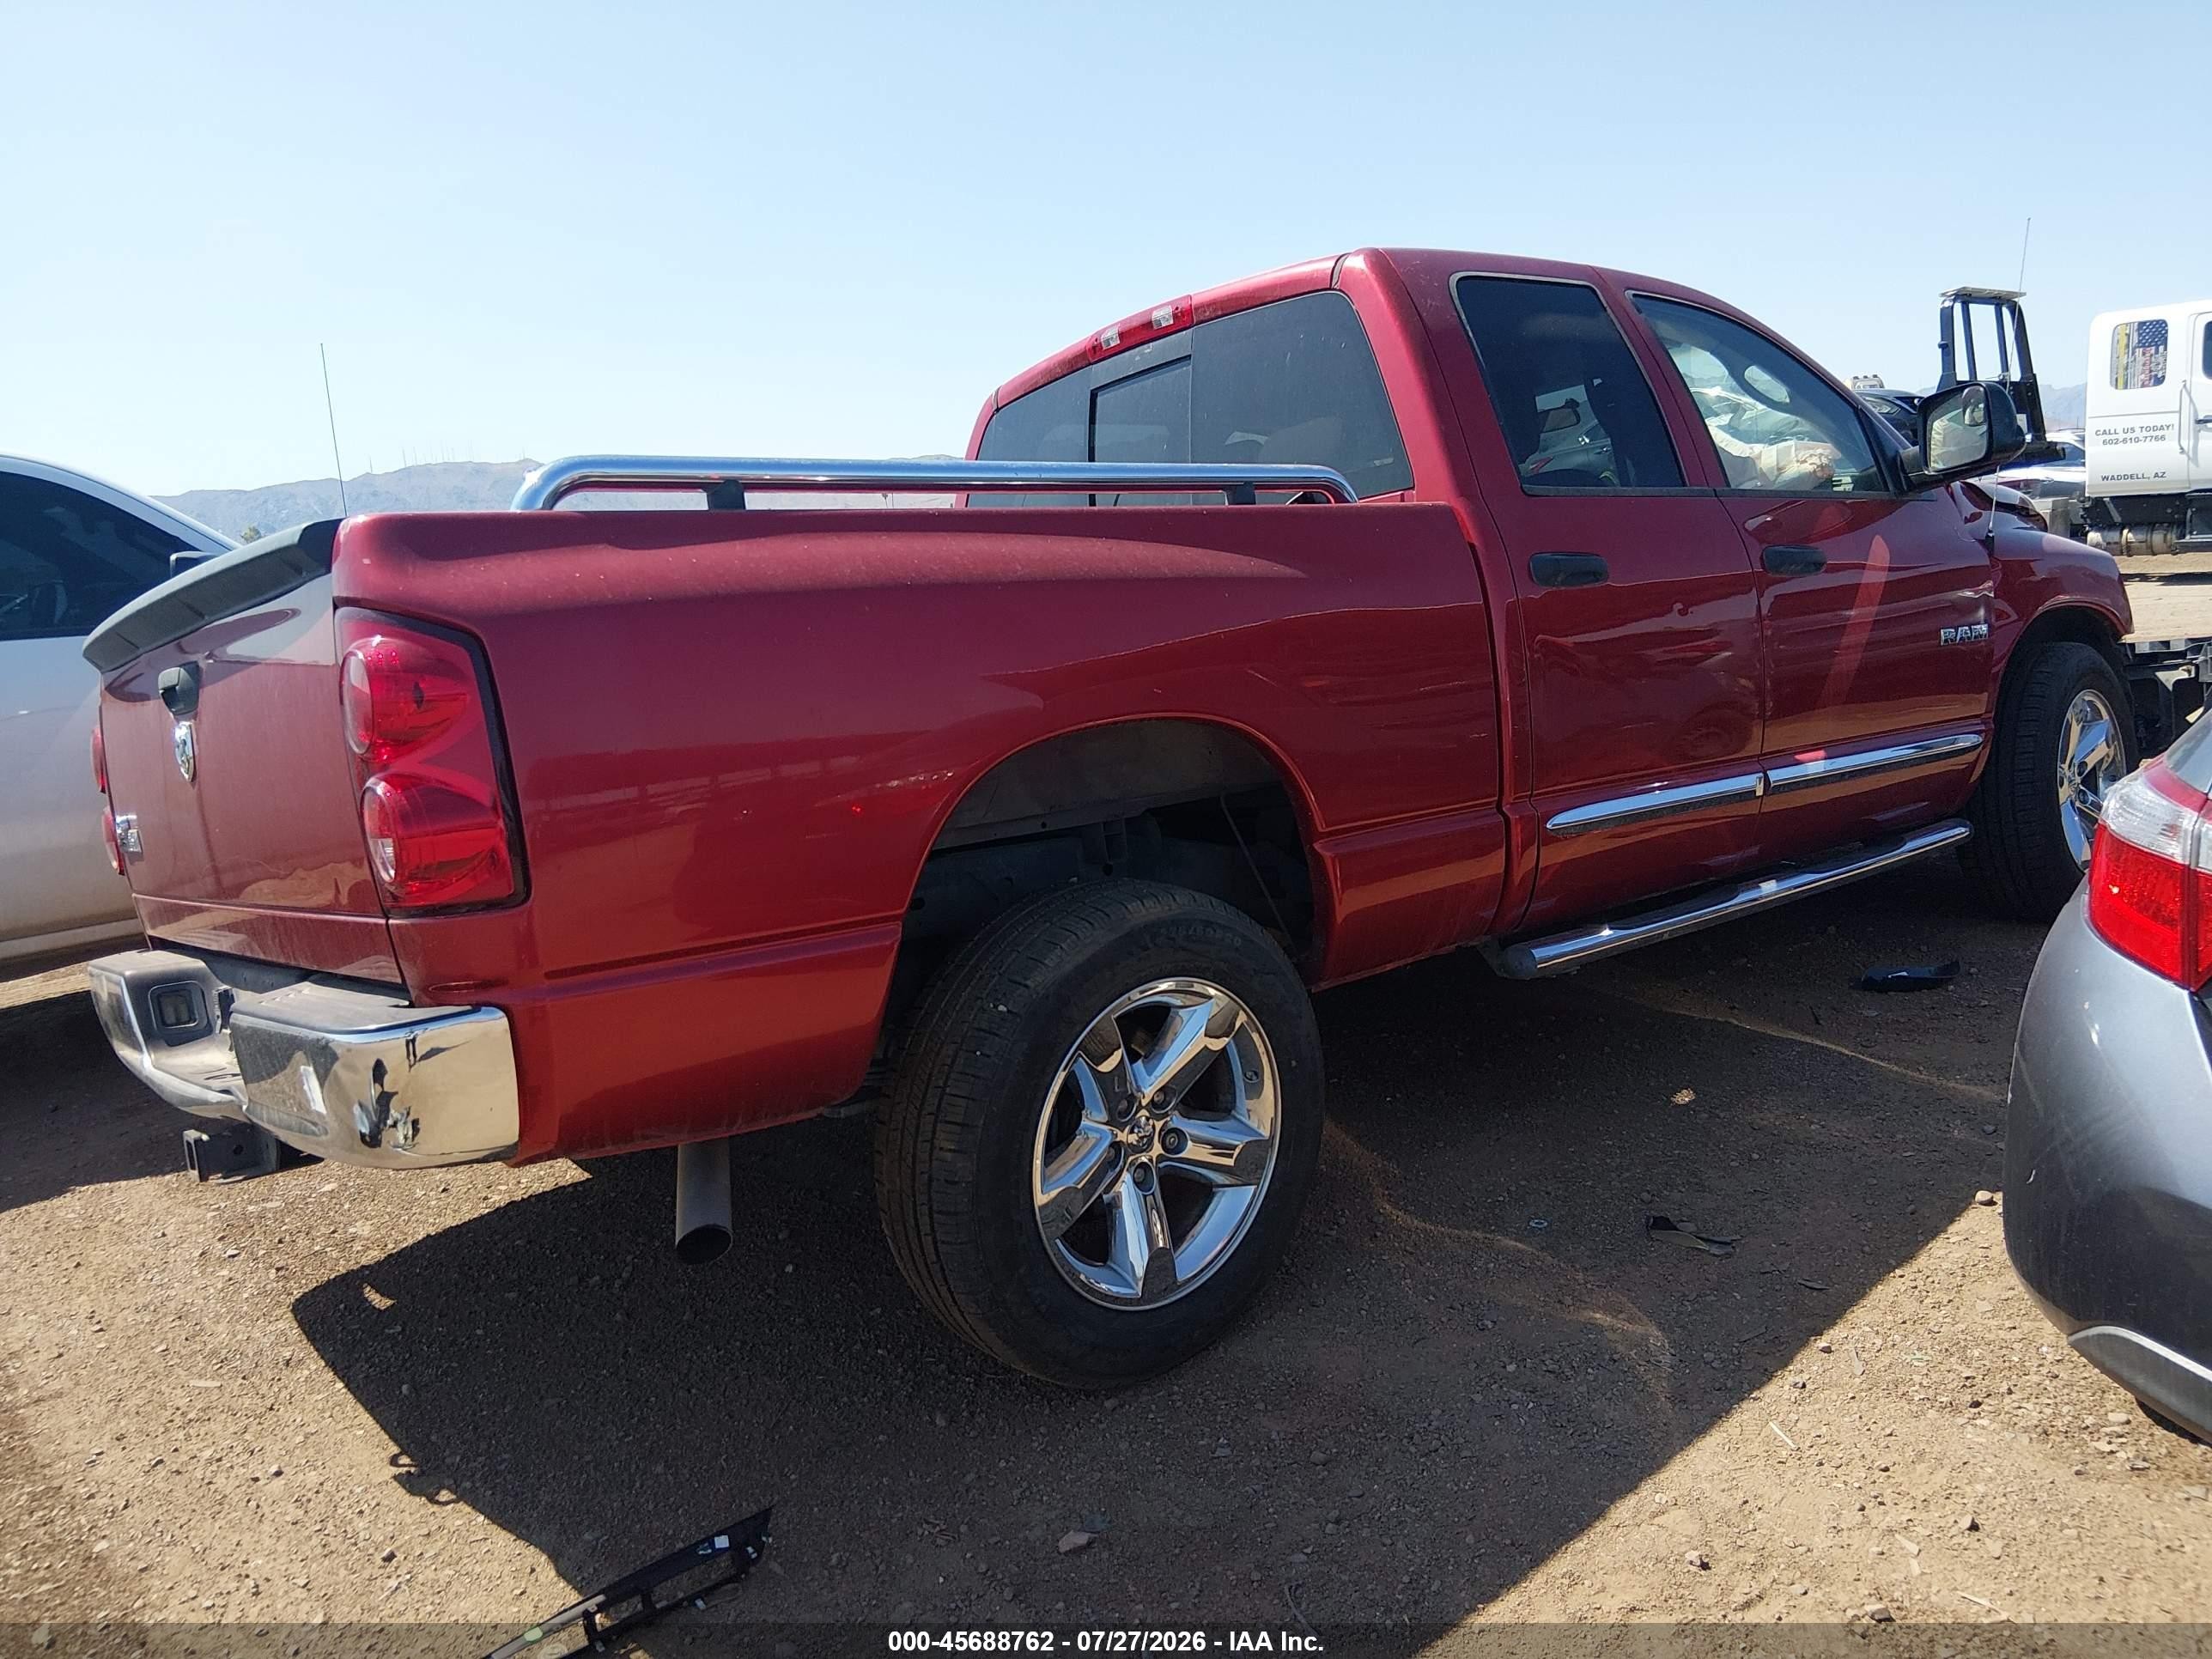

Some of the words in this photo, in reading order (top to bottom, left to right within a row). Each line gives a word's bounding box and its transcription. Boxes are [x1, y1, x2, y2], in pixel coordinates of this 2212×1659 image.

[2139, 423, 2174, 433] TODAY!
[2101, 473, 2150, 483] WADDELL,
[1941, 623, 1988, 646] RAM
